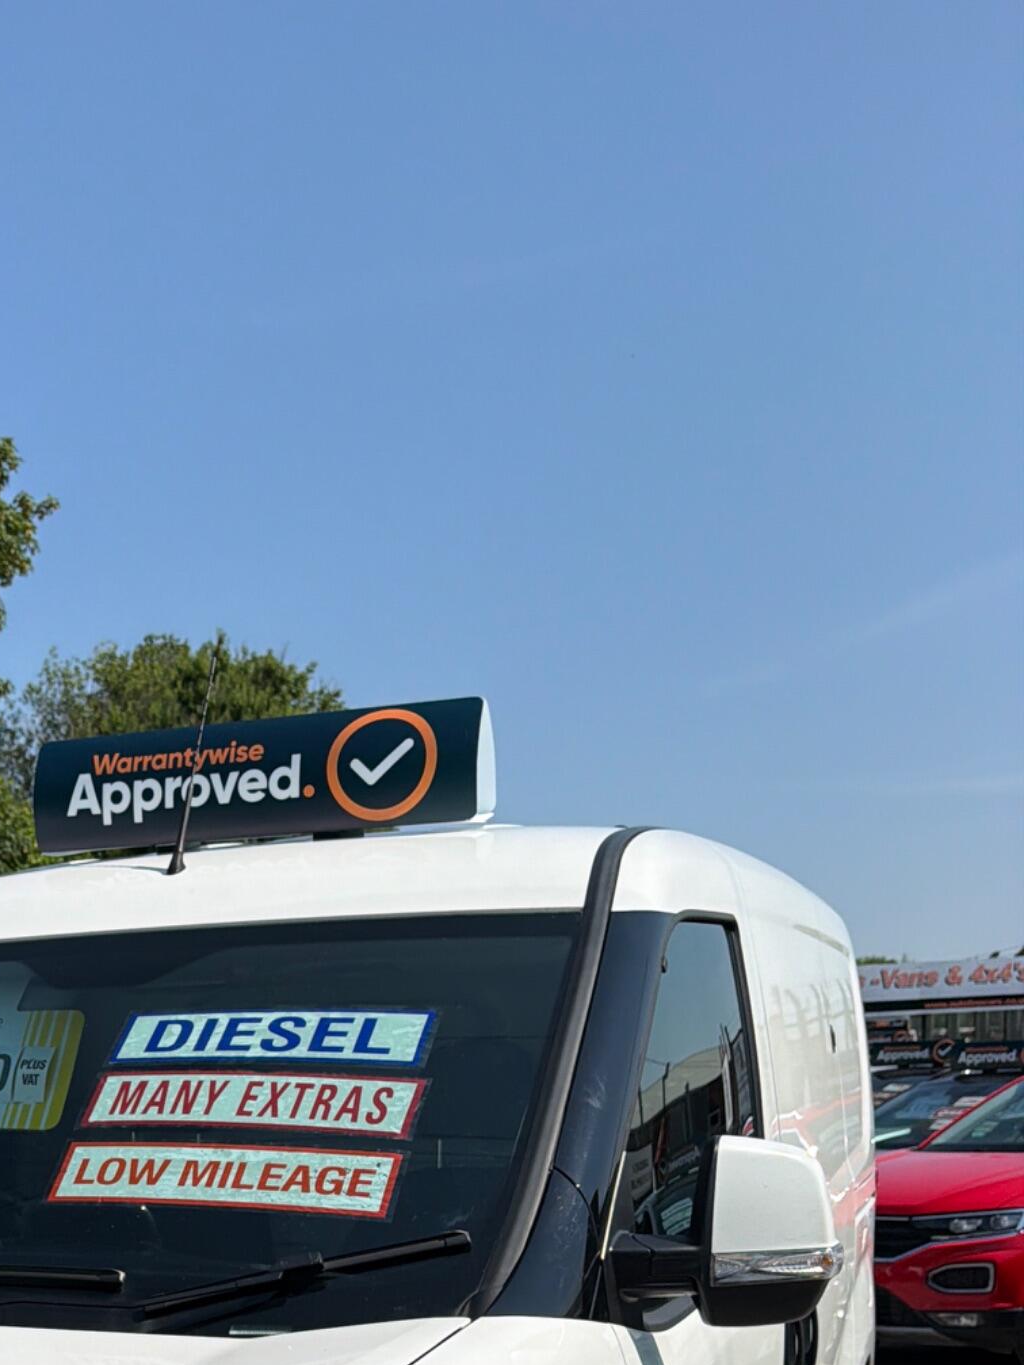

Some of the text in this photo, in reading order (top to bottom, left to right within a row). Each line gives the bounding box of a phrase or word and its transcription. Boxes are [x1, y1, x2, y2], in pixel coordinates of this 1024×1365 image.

[92, 740, 265, 776] Warrantywise
[944, 964, 963, 986] &
[144, 1016, 392, 1055] DIESEL
[19, 1059, 47, 1070] PLUS
[22, 1074, 40, 1086] VAT
[109, 1080, 393, 1125] MANY EXTRAS
[73, 1157, 378, 1197] LOW MILEAGE
